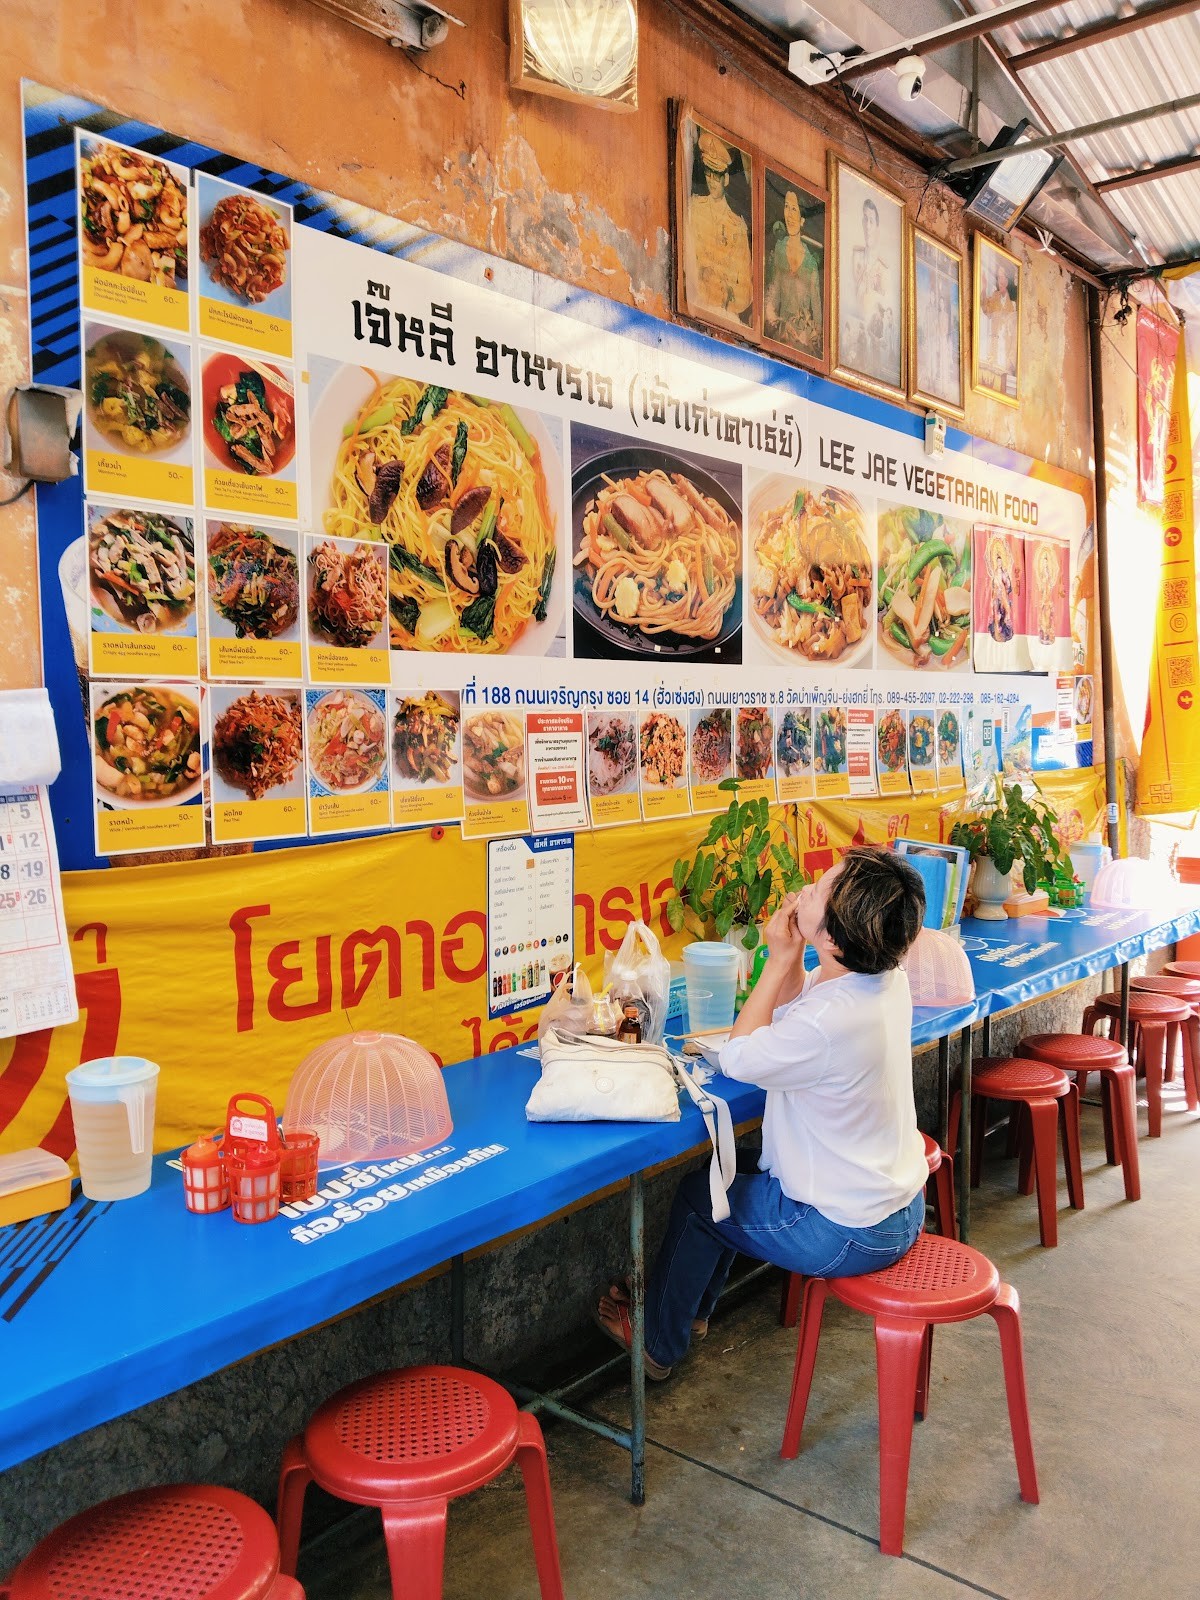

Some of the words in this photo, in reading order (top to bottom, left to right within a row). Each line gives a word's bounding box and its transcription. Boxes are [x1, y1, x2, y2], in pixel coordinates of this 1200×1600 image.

[351, 279, 456, 366] เจ๊หลี
[475, 336, 613, 410] อาหารเจ
[168, 471, 183, 479] 50.-
[819, 436, 856, 475] LEE
[861, 451, 897, 487] JAE
[903, 462, 999, 516] VEGETARIAN
[1004, 494, 1039, 526] FOOD
[461, 675, 476, 704] ที่
[482, 686, 511, 705] 188
[515, 686, 603, 709] ถนนเจริญกรุง
[607, 689, 631, 705] ซอย
[635, 689, 649, 705] 14
[653, 681, 704, 708] (ฮั่วเซ่งฮง)
[707, 690, 767, 705] ถนนเยาวราช
[770, 690, 784, 704] ซ.8
[870, 688, 885, 705] โทร.
[558, 775, 567, 784] 10
[20, 803, 31, 819] 5
[19, 831, 41, 848] 12
[24, 860, 44, 877] 19
[27, 888, 47, 906] 26
